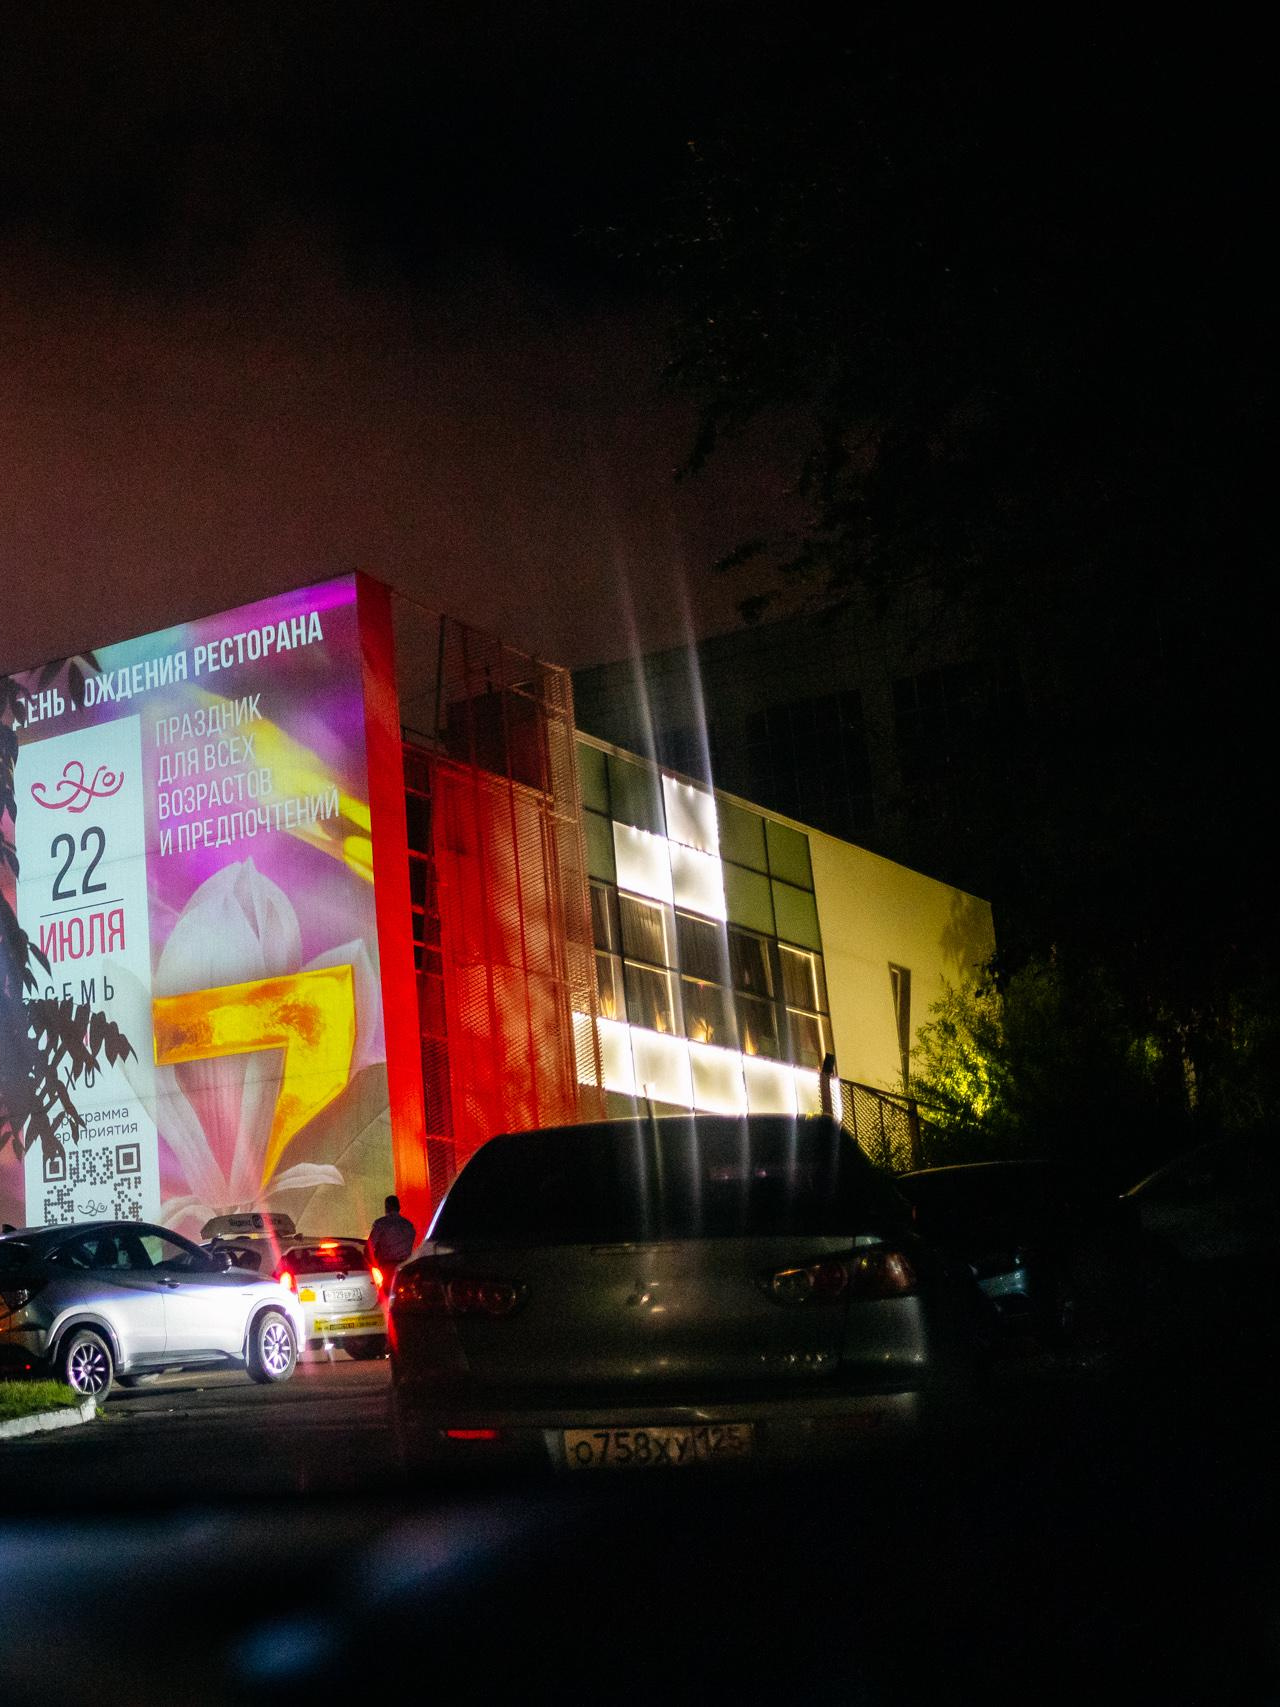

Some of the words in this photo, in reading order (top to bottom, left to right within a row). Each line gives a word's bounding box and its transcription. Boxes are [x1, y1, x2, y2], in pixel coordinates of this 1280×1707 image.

[71, 650, 188, 711] ОЖДЕНИЯ
[194, 610, 324, 677] РЕСТОРАНА
[155, 693, 263, 748] ПРАЗДНИК
[158, 744, 200, 787] ДЛЯ
[204, 733, 256, 772] ВСЕХ
[158, 766, 274, 821] ВОЗРАСТОВ
[160, 829, 174, 857] И
[178, 784, 341, 853] ПРЕДПОЧТЕНИЙ
[50, 826, 108, 901] 22
[39, 908, 126, 963] ИЮЛЯ
